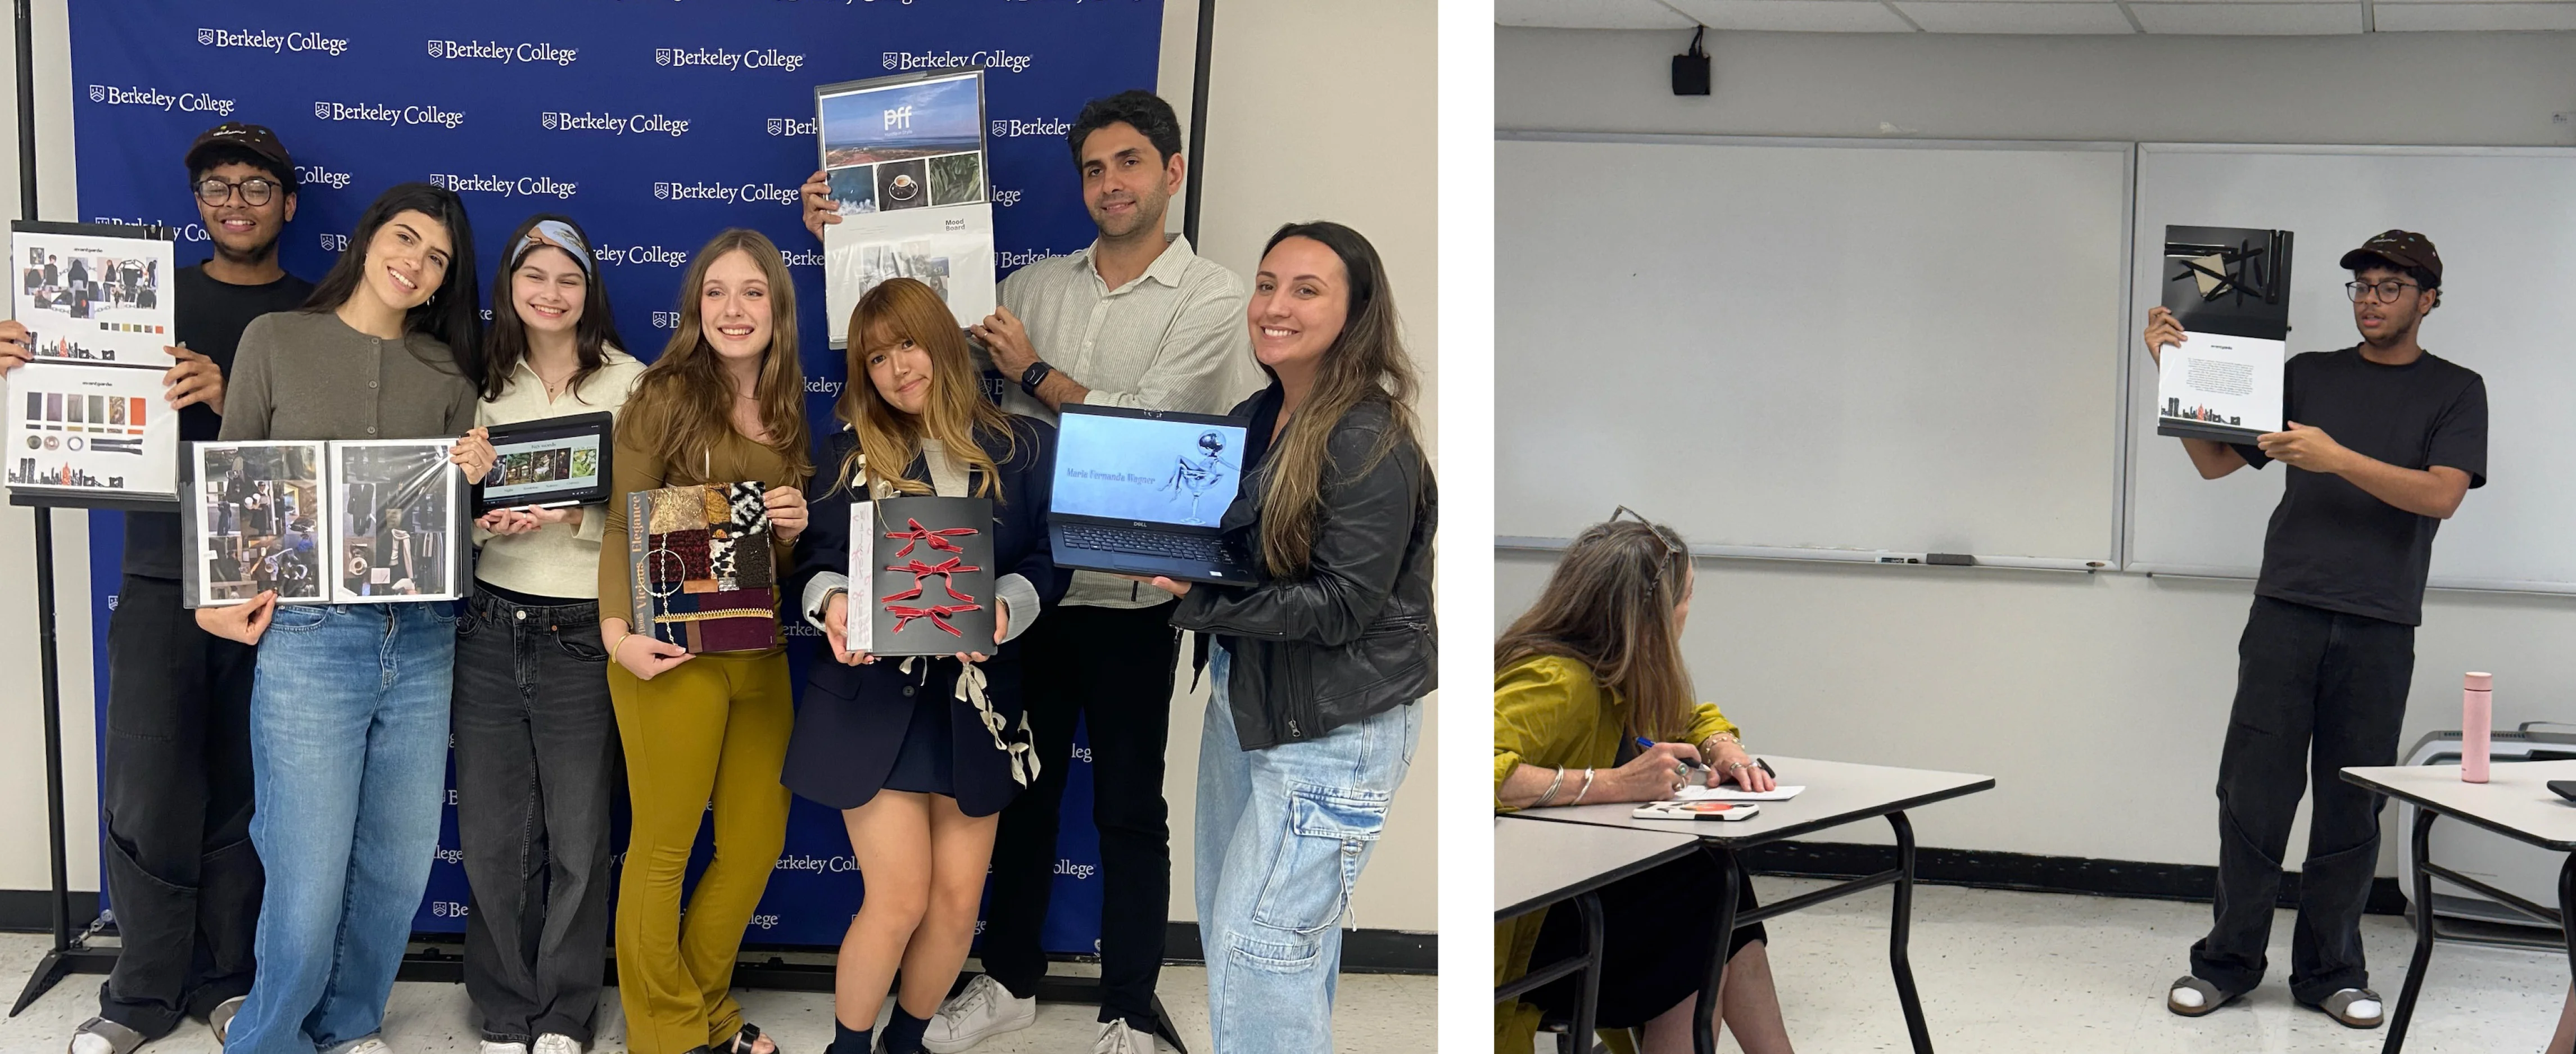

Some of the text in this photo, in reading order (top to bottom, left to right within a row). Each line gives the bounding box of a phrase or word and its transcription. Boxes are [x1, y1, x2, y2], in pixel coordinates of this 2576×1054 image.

[216, 29, 347, 56] Berkeley College
[445, 40, 576, 66] Berkeley College
[673, 48, 803, 71] Berkeley College
[971, 50, 1030, 73] College
[107, 87, 234, 116] Berkeley College
[333, 103, 463, 128] Berkeley College
[559, 112, 690, 136] Berkeley College
[784, 117, 818, 136] Berk
[447, 174, 576, 199] Berkeley College
[671, 182, 799, 205] Berkeley College
[992, 184, 1021, 207] lege
[593, 244, 686, 267] eley College
[780, 249, 825, 268] Berke
[803, 376, 843, 397] keley
[1067, 468, 1156, 485] Maria Fernanda Wagner
[632, 496, 646, 609] Vicious Elegance
[434, 844, 463, 864] lege
[776, 855, 827, 874] erkeley
[1053, 859, 1094, 879] ollege
[750, 913, 778, 929] lege
